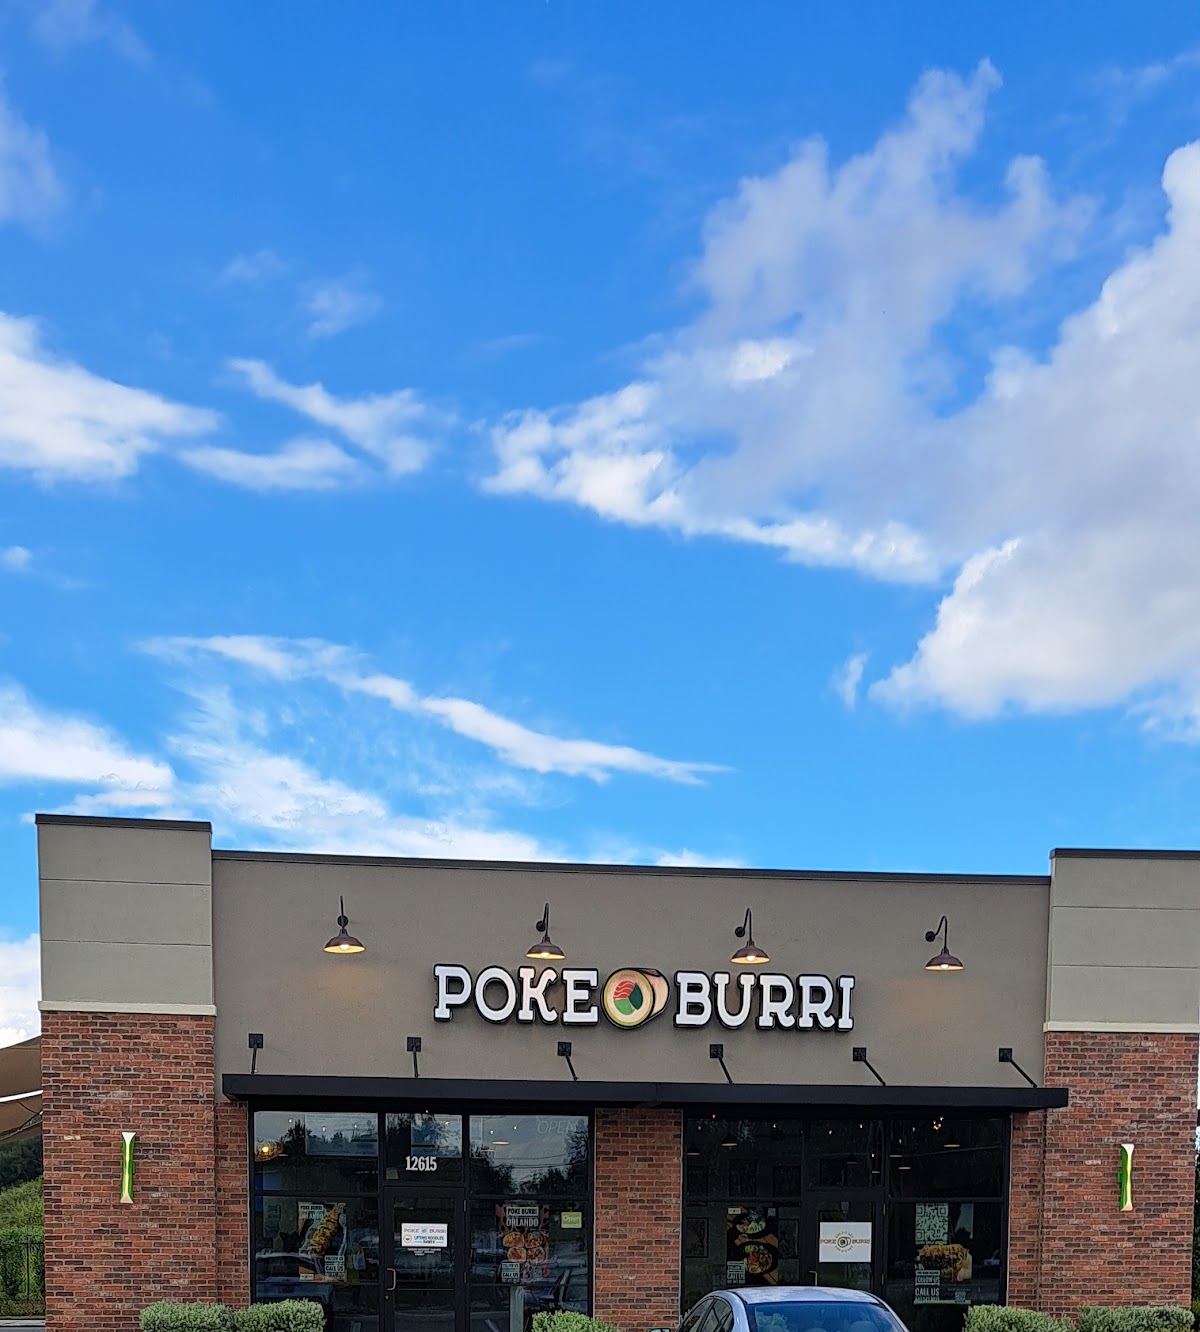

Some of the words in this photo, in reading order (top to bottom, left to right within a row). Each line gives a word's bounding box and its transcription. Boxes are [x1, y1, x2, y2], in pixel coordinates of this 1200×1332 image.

[434, 964, 599, 1024] POKE
[674, 971, 855, 1031] BURRI
[537, 1120, 577, 1134] OPEN
[405, 1156, 437, 1171] 12615
[506, 1216, 539, 1227] ORLANDO
[914, 1287, 930, 1296] CALL
[930, 1287, 940, 1296] US
